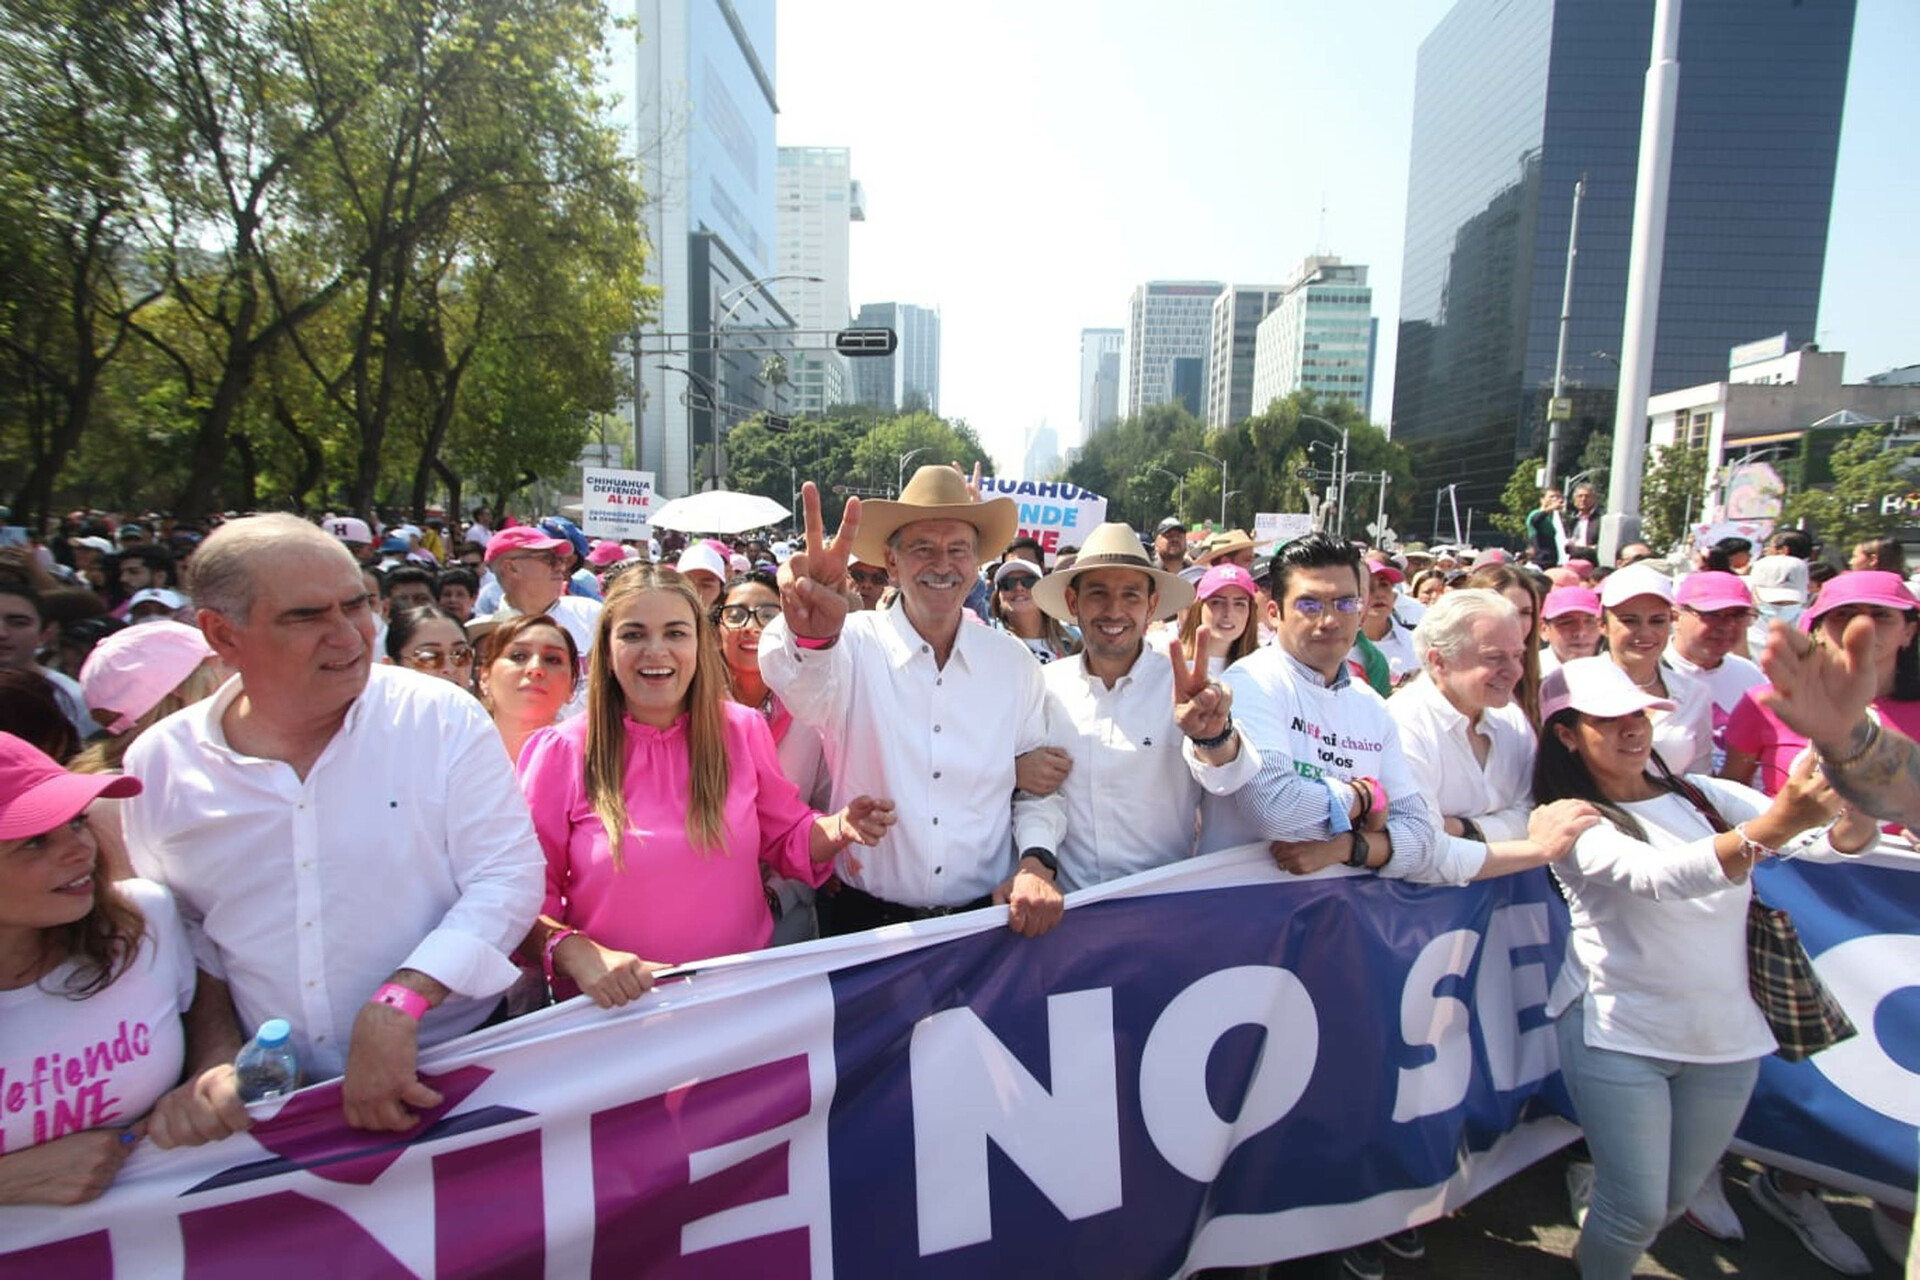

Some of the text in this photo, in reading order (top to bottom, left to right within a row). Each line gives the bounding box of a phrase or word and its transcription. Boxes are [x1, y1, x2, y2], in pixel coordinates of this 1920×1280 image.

[586, 476, 650, 489] CHIHUAHUA
[593, 485, 643, 495] DEFIENDE
[607, 494, 649, 506] AL INE
[333, 524, 348, 536] H
[1341, 736, 1383, 752] chairo
[909, 965, 1319, 1257] NO
[1392, 903, 1561, 1123] SE
